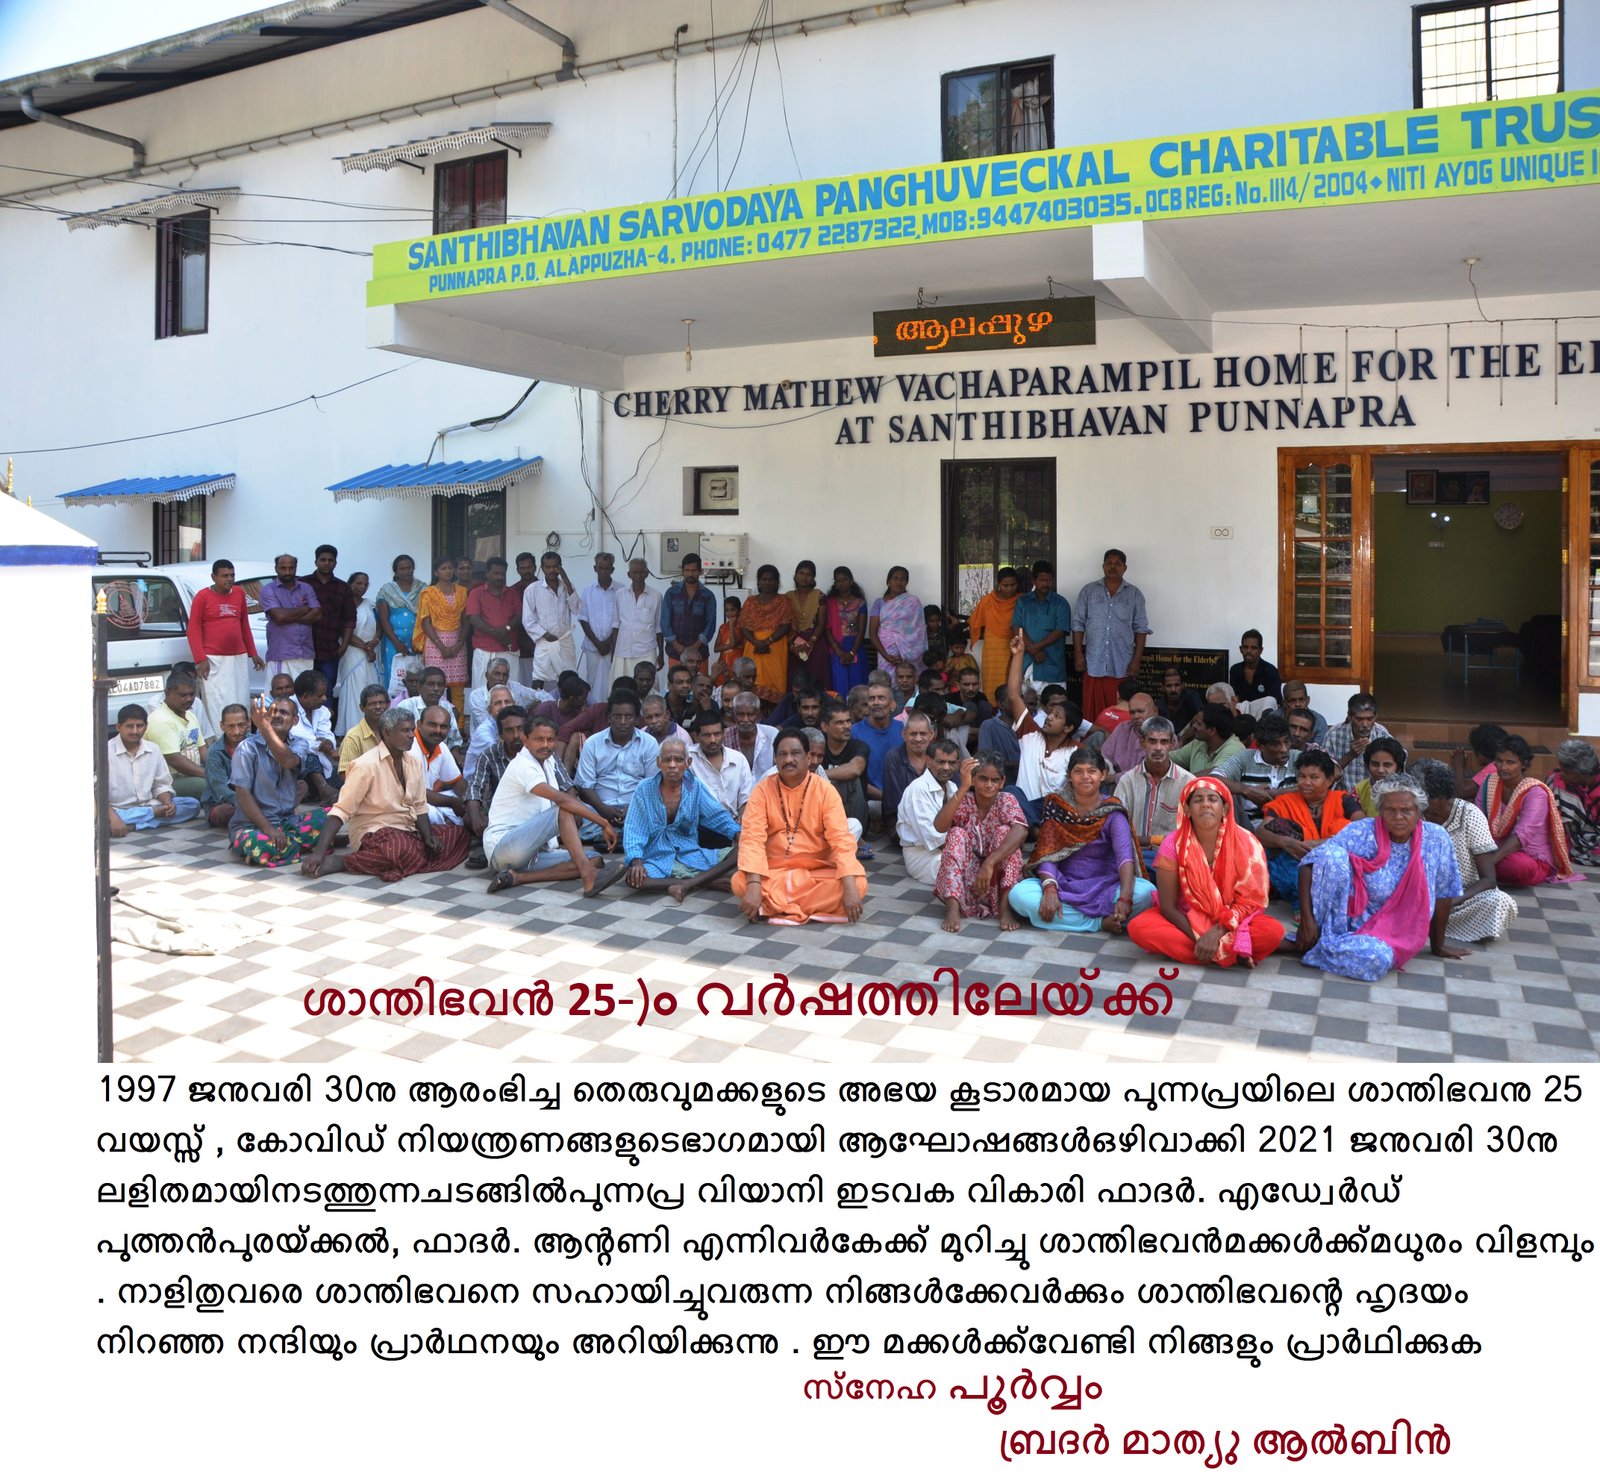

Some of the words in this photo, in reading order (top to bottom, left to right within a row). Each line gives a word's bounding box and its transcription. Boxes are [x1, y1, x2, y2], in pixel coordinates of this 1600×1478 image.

[409, 215, 610, 270] SANTHIBHAVAN
[619, 188, 803, 242] SARVODAYA
[816, 149, 1130, 217] PANGHUVECKAL
[1149, 115, 1439, 178] CHARITABLE
[1461, 97, 1600, 149] TRUS
[429, 266, 507, 292] PUNNAPRA
[757, 227, 812, 253] 0477
[1146, 187, 1183, 213] OCB
[1387, 165, 1425, 192] NITI
[1435, 159, 1493, 188] AYOG
[1501, 150, 1585, 183] UNIQUE
[896, 311, 1053, 350] ആലപ്പുഴ
[613, 385, 732, 418] CHERRY
[743, 376, 884, 411] MATHEW
[895, 358, 1201, 402] VACHAPARAMPIL
[1213, 351, 1338, 388] HOME
[1351, 347, 1437, 383] FOR
[1450, 342, 1542, 379] THE
[835, 415, 875, 445] AT
[888, 403, 1169, 444] SANTHIBHAVAN
[1189, 394, 1417, 433] PUNNAPRA
